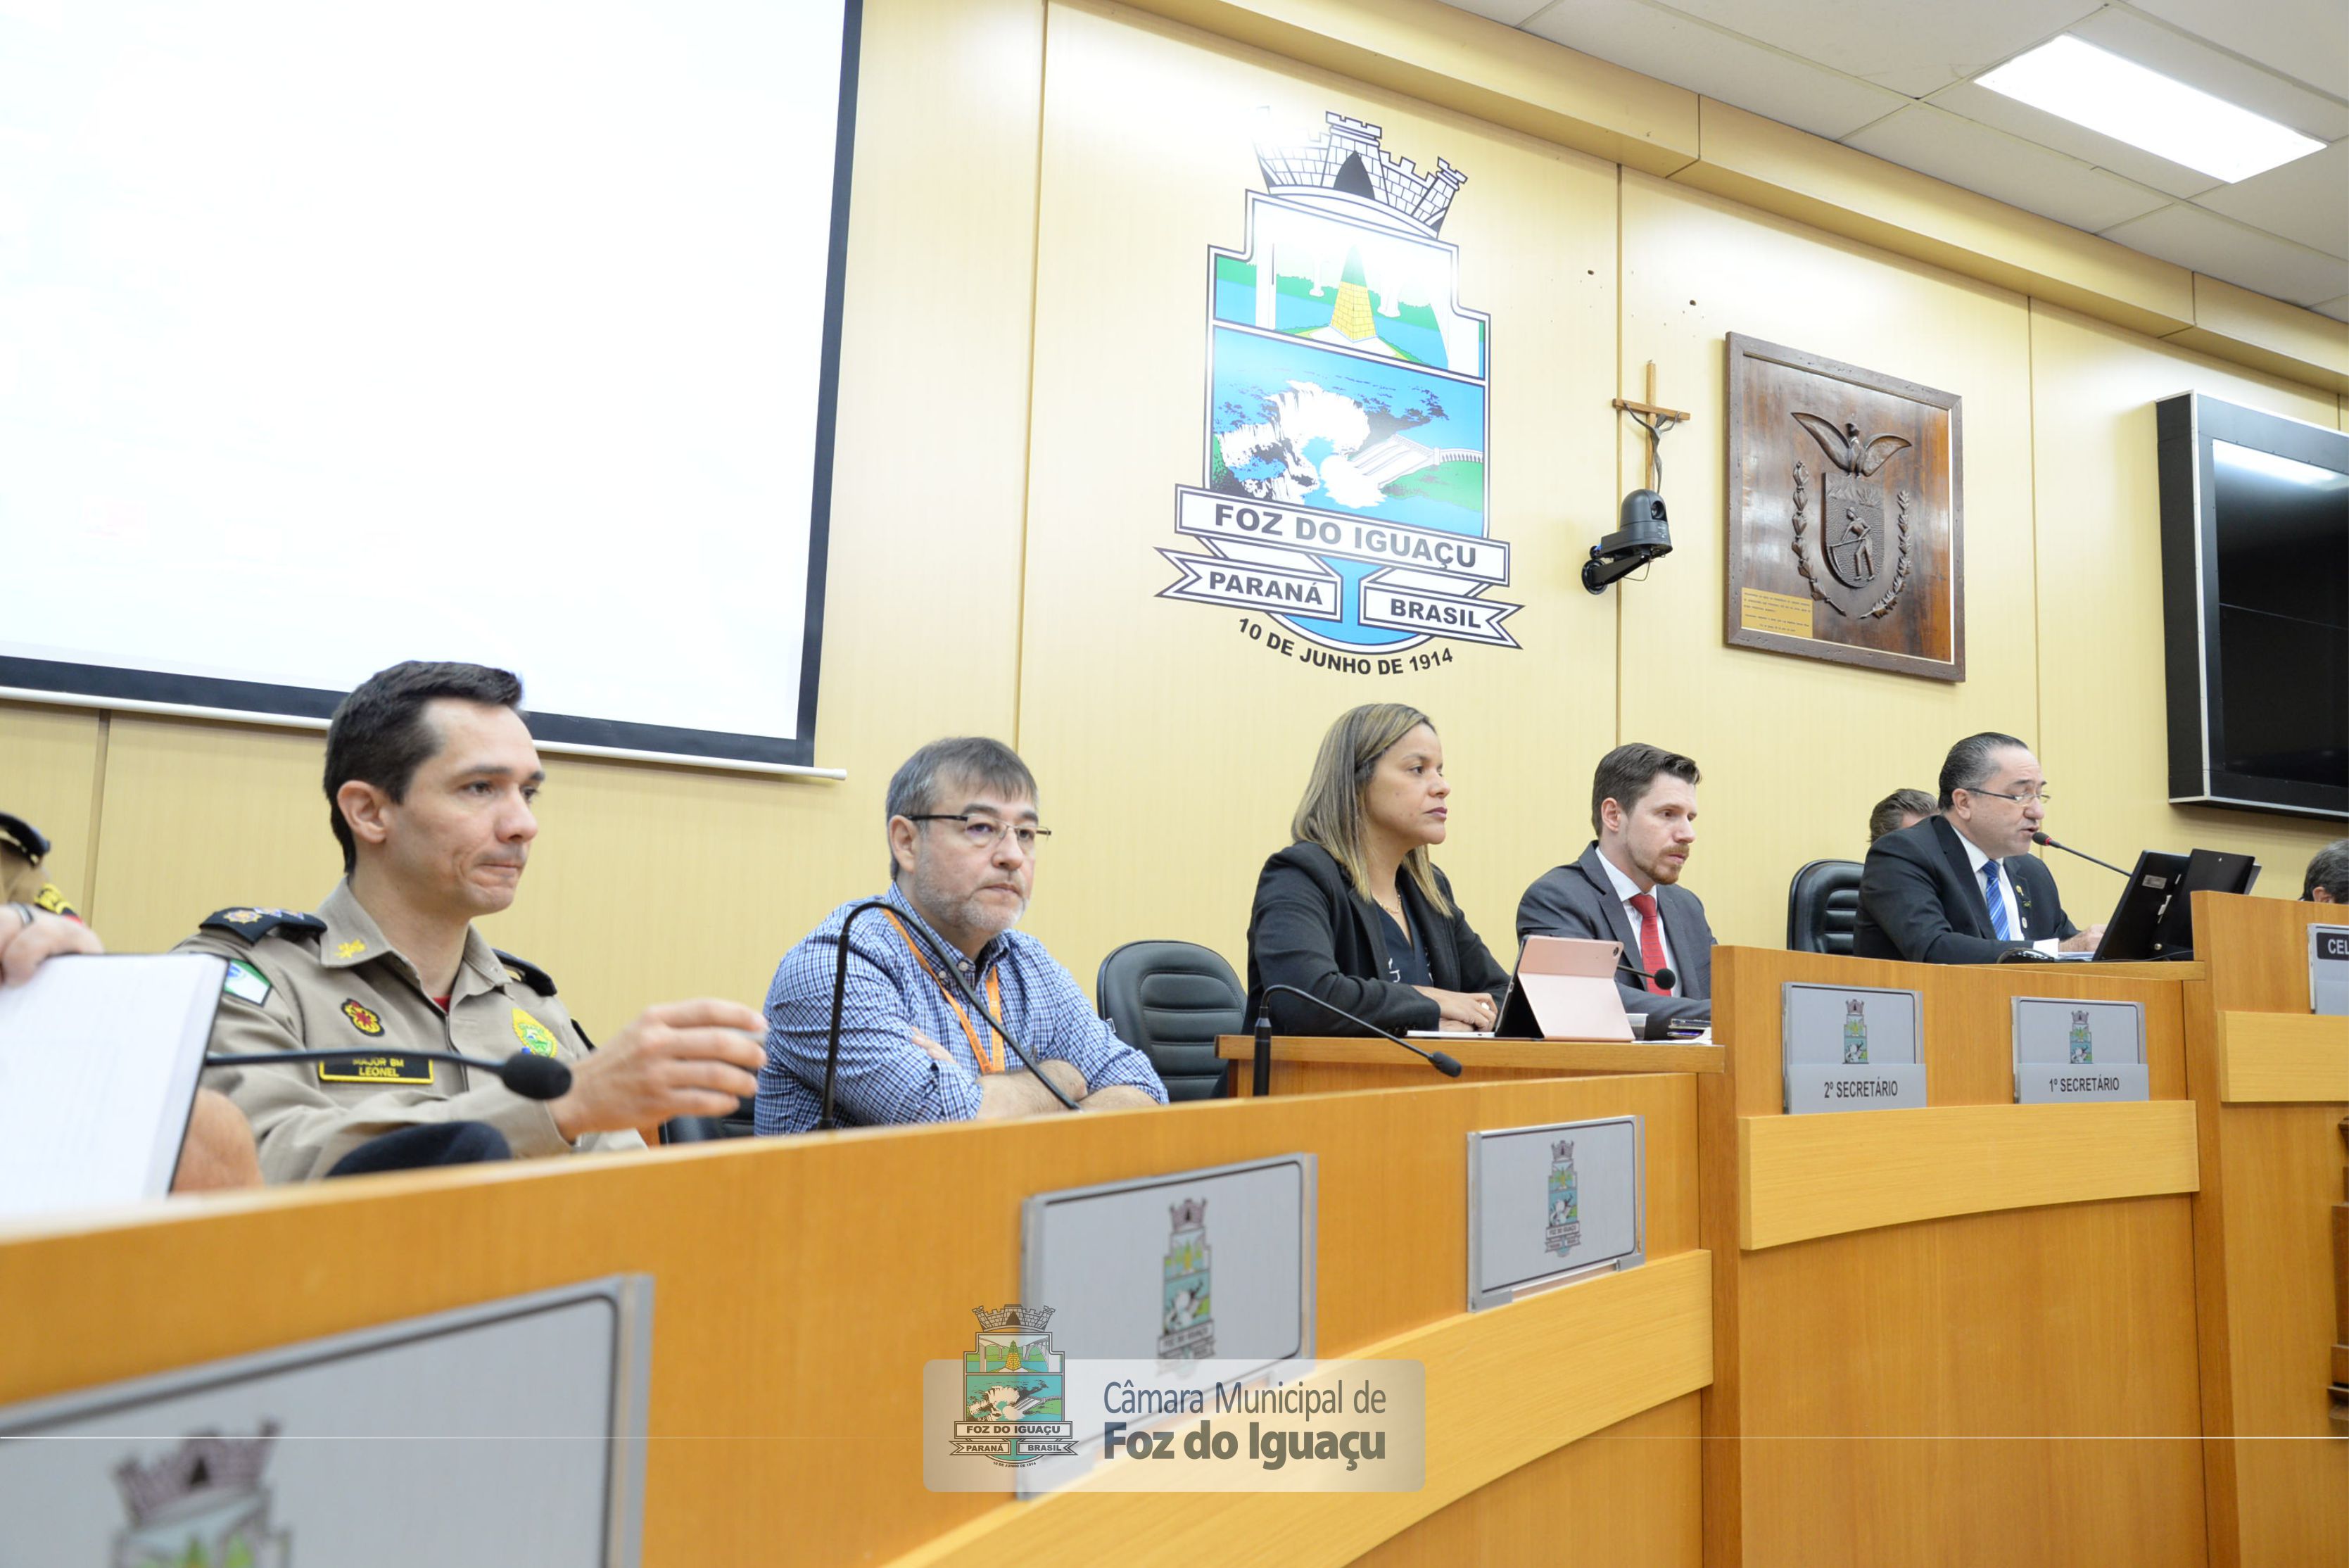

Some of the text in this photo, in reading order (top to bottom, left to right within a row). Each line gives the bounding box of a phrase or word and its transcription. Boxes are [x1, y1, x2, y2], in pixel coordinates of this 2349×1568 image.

[1215, 503, 1476, 569] FOZ DO IGUAÇU
[1209, 571, 1323, 605] PARANÁ
[1390, 598, 1481, 628] BRASIL
[1239, 617, 1453, 676] 10 DE JUNHO DE 1914
[359, 1066, 400, 1077] LEONEL
[1836, 1075, 1898, 1098] SECRETÁRIO
[2060, 1073, 2120, 1092] SECRETÁRIO
